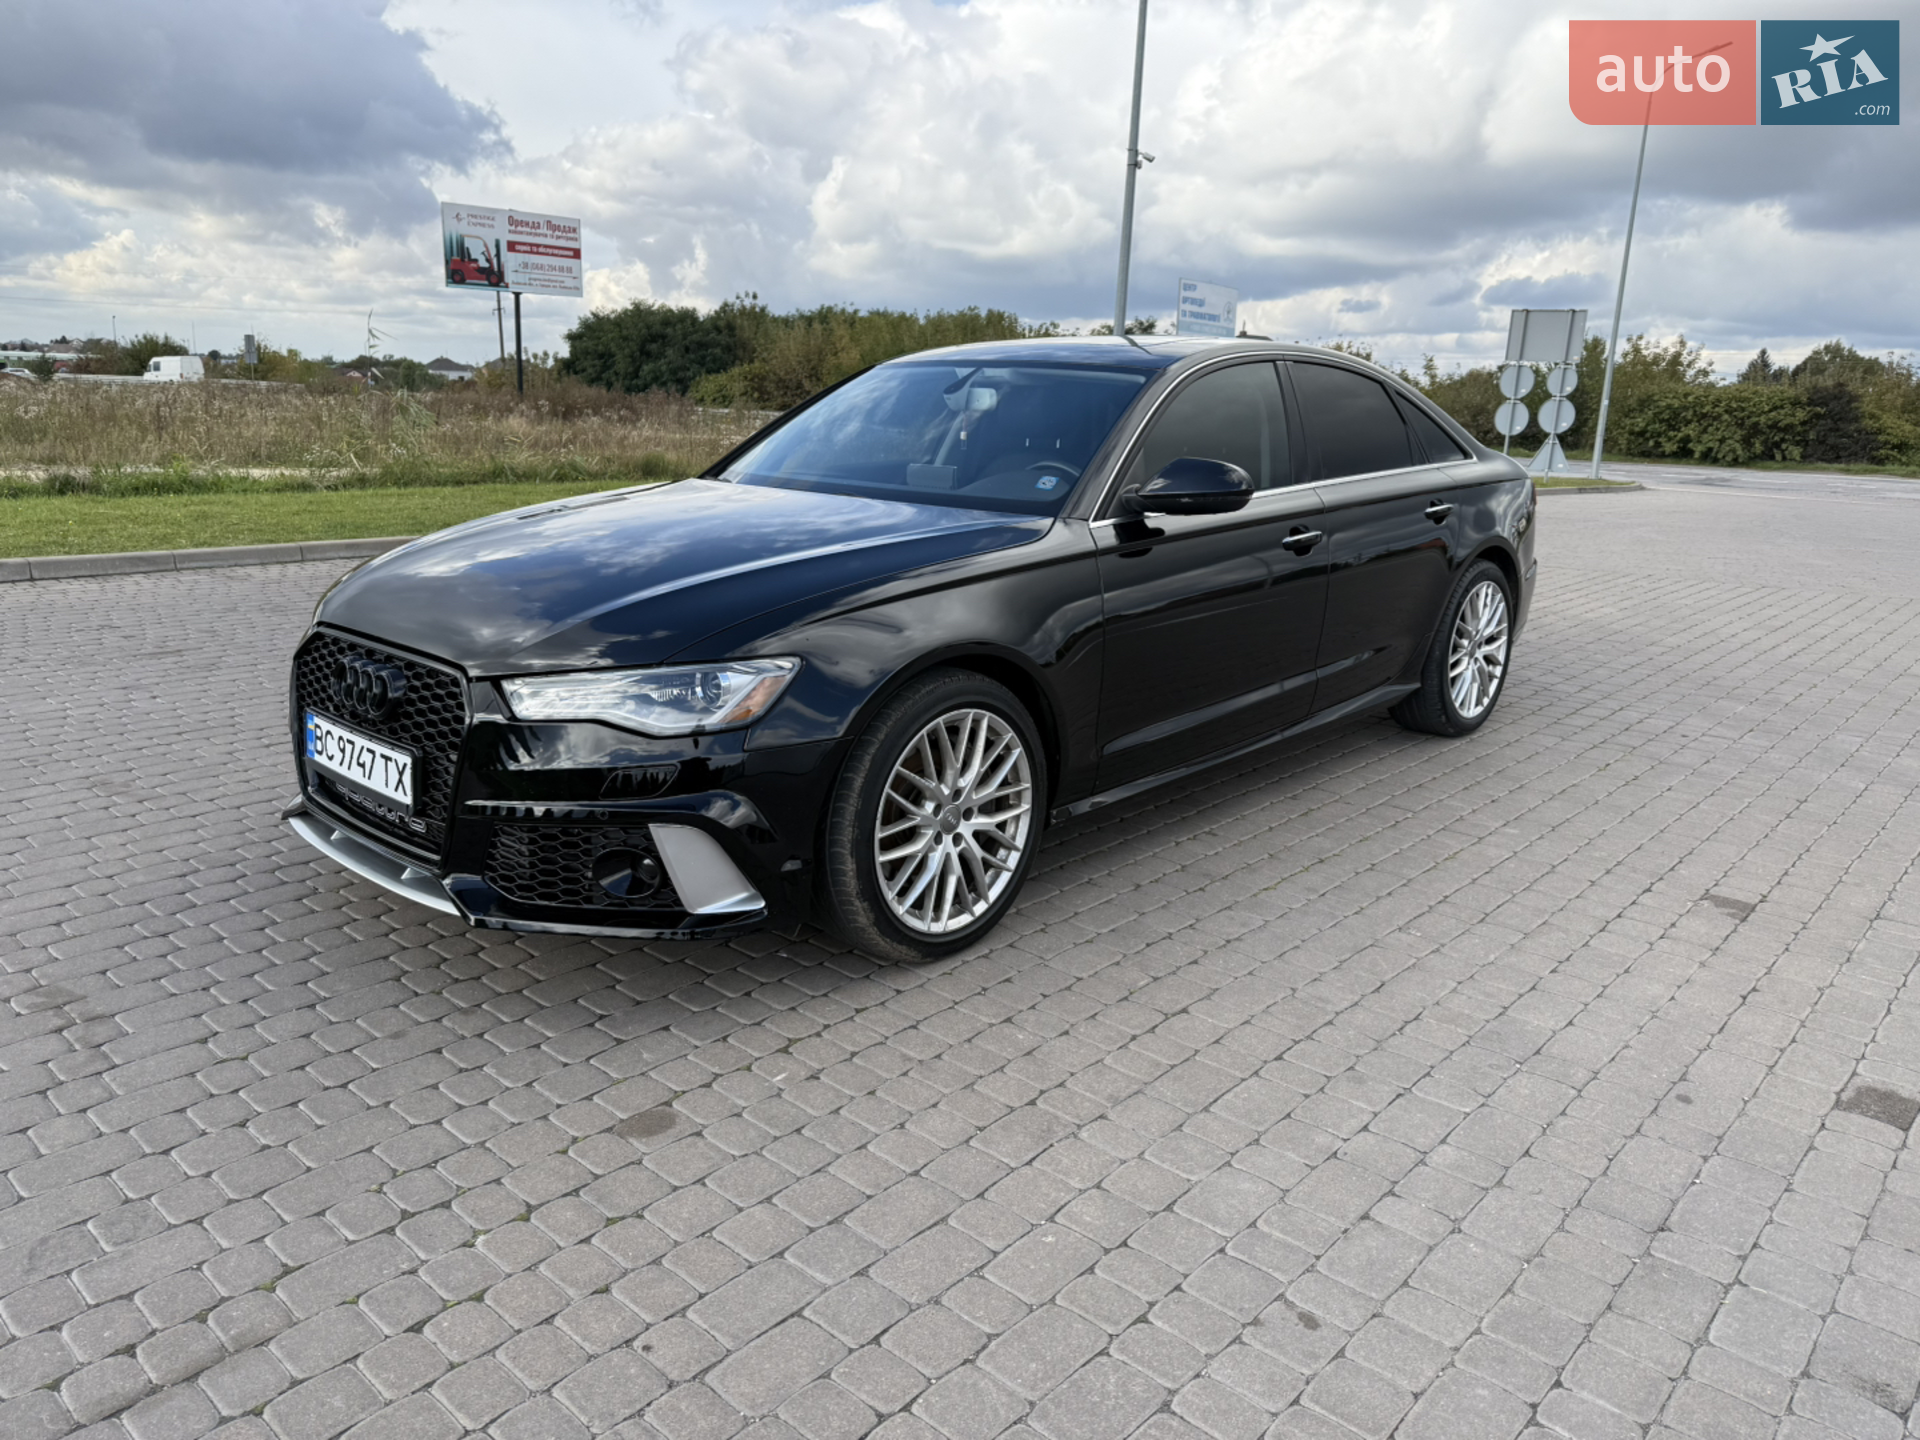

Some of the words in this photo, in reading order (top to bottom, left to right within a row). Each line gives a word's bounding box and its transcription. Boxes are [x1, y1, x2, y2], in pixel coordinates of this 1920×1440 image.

[466, 213, 496, 222] PRESTIGE
[467, 220, 495, 229] EXPRESS
[507, 215, 541, 230] Оренда
[546, 220, 578, 235] Продаж
